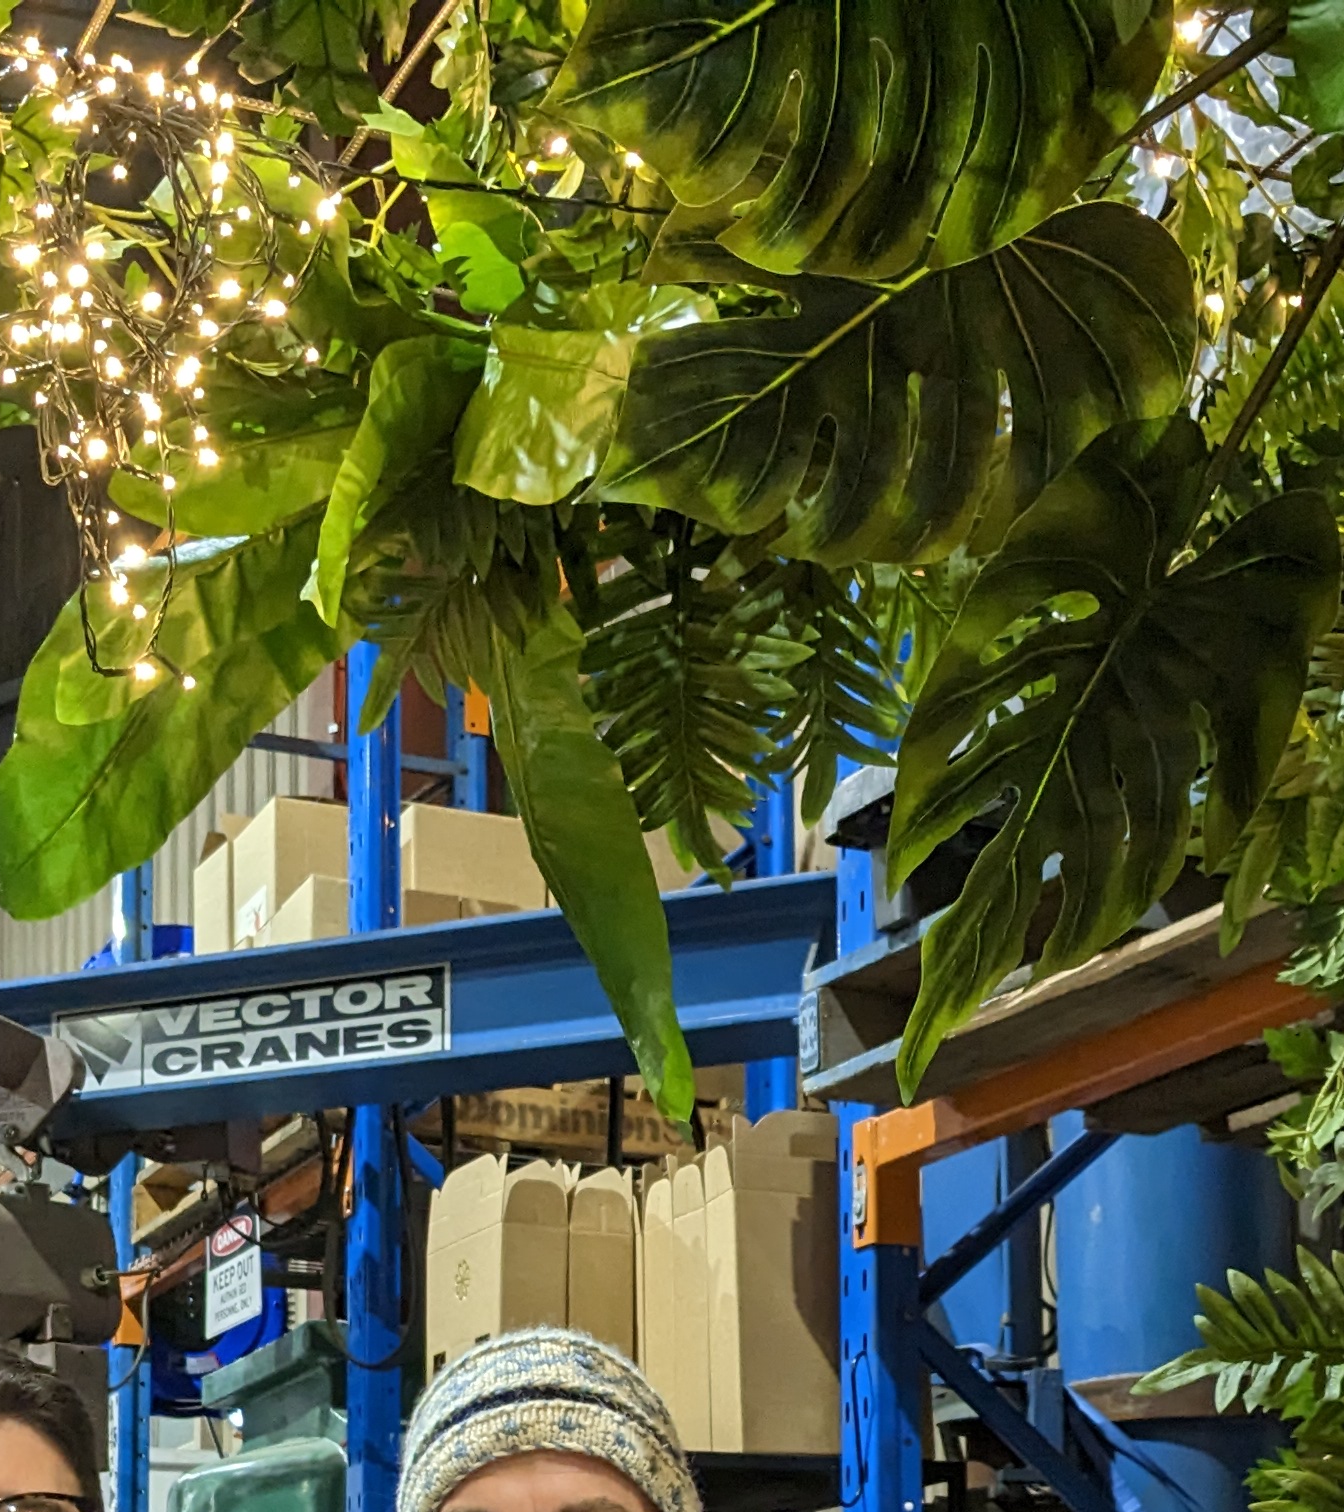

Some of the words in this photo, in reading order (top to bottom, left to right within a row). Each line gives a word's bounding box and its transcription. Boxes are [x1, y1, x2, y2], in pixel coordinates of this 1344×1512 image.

[155, 974, 433, 1037] VECTOR
[151, 1017, 433, 1077] CRANES
[212, 1266, 235, 1294] KEEP
[236, 1254, 255, 1279] OUT
